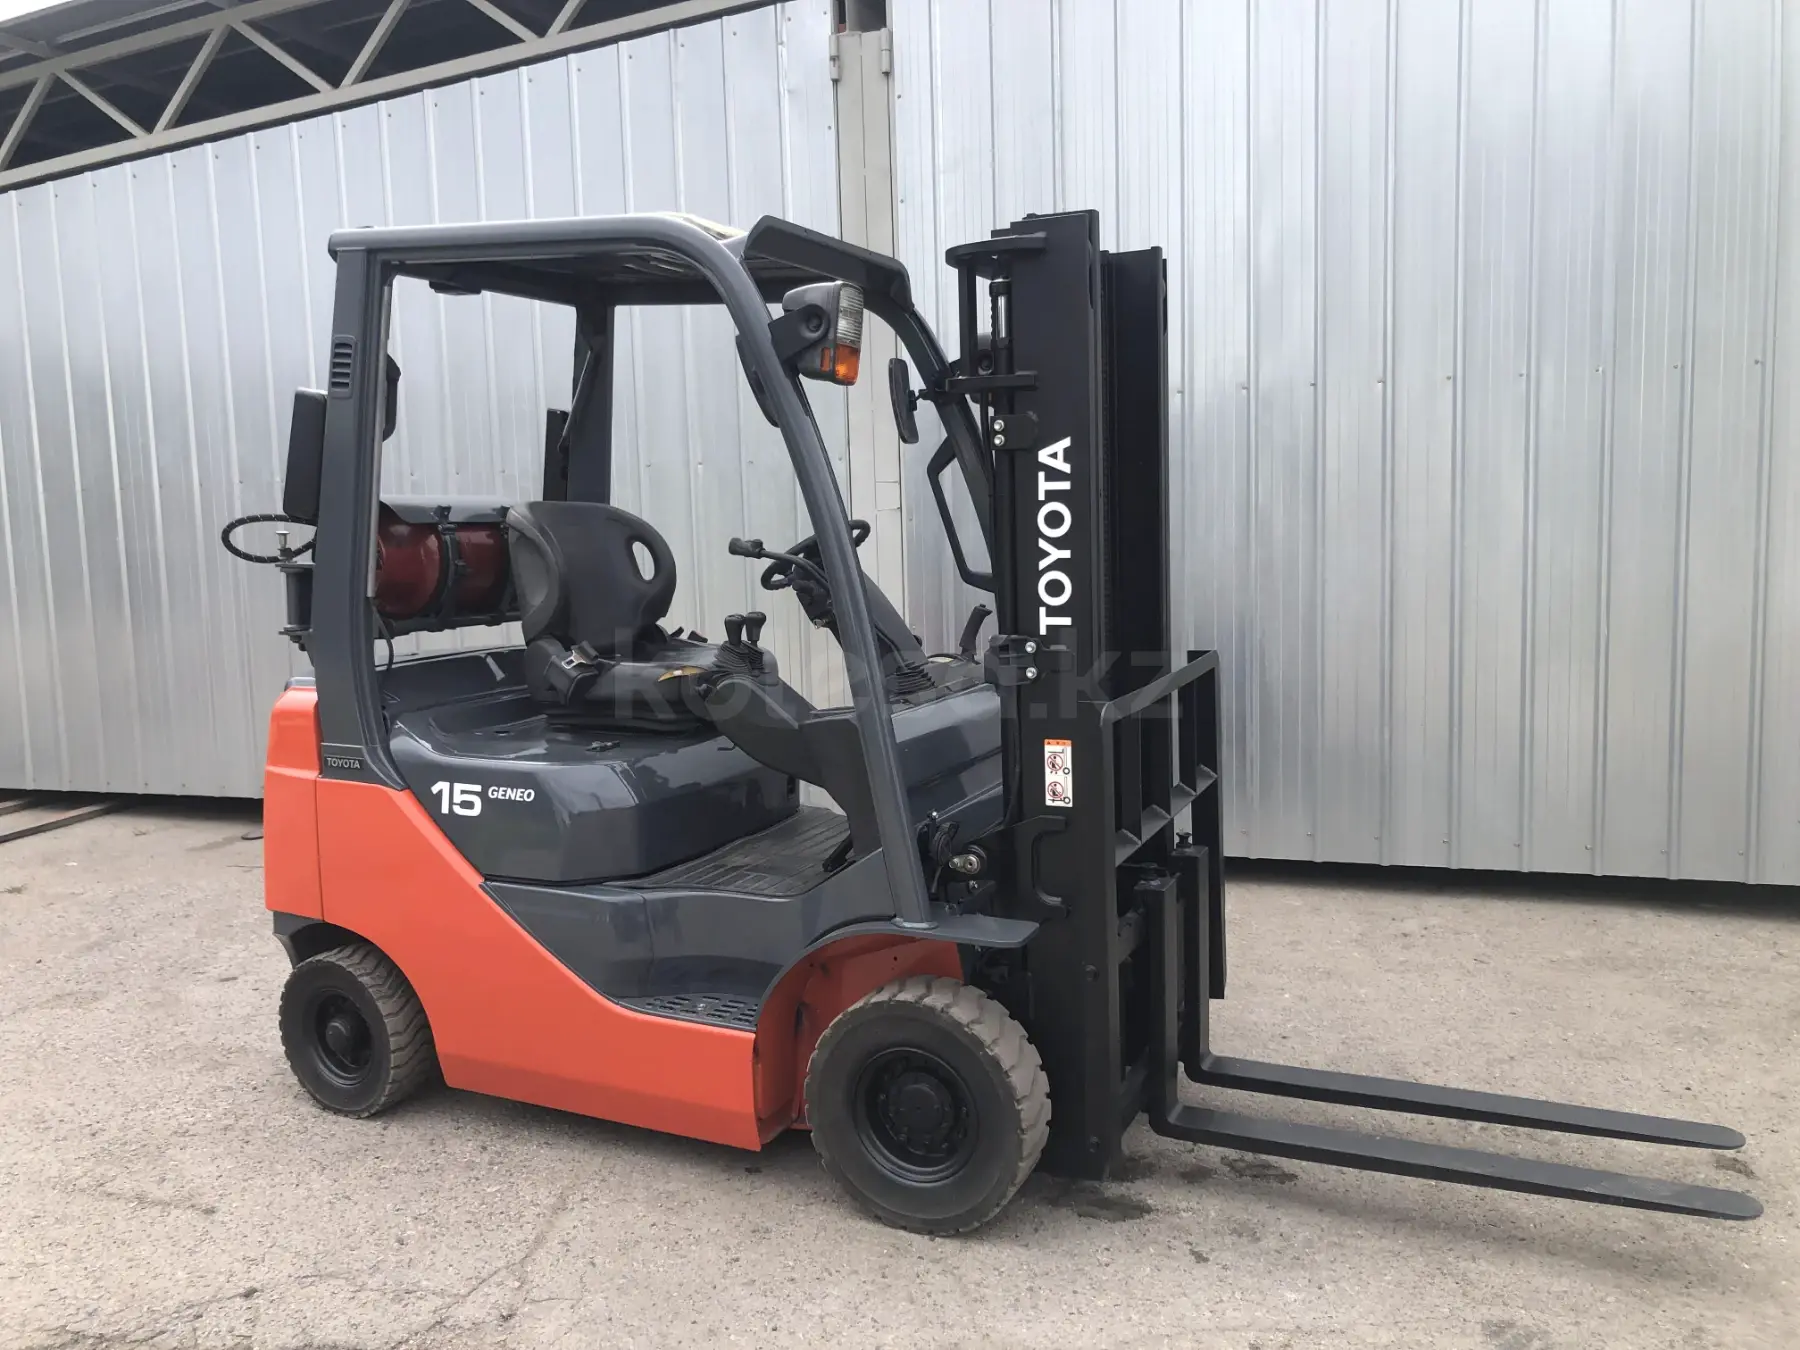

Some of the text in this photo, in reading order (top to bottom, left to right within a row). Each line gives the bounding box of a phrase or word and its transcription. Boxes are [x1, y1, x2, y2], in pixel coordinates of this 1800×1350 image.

[1037, 436, 1072, 635] TOYOTA
[326, 757, 361, 769] TOYOTA
[430, 781, 535, 817] 15 GENEO
